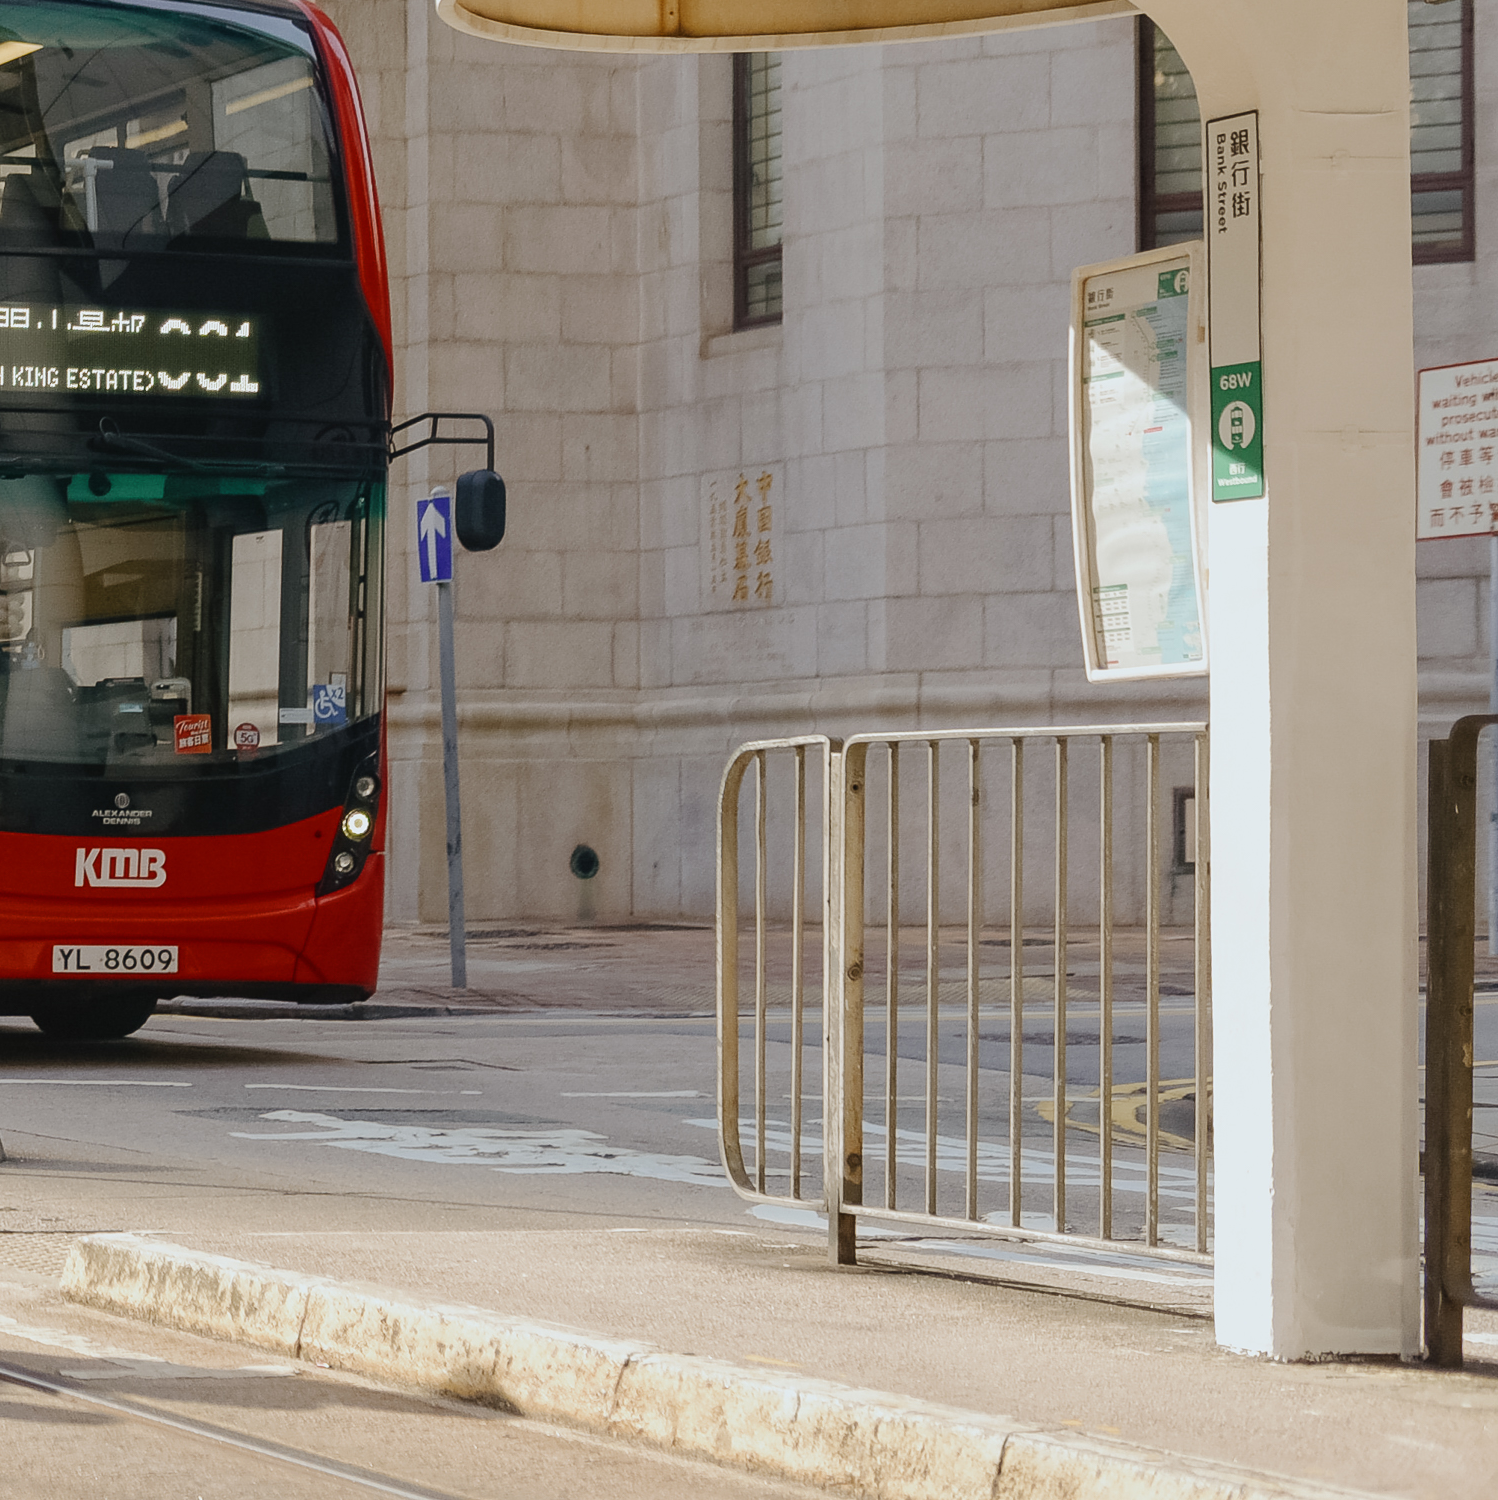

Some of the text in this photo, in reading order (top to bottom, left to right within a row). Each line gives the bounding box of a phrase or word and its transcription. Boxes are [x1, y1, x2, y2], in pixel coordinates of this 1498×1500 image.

[1230, 129, 1250, 218] 銀行街
[1217, 133, 1228, 234] Bank Street
[11, 366, 59, 389] KING
[1219, 372, 1252, 390] 68W
[1432, 393, 1477, 409] waiting
[1425, 427, 1474, 446] without
[1217, 474, 1258, 487] Westbound
[754, 470, 773, 601] 中國銀行
[176, 719, 208, 735] Tourist
[240, 732, 254, 743] 5G
[91, 809, 153, 818] ALEXANDER
[102, 817, 141, 825] DENNIS
[74, 847, 167, 888] KMB
[58, 948, 174, 971] YL 8609
